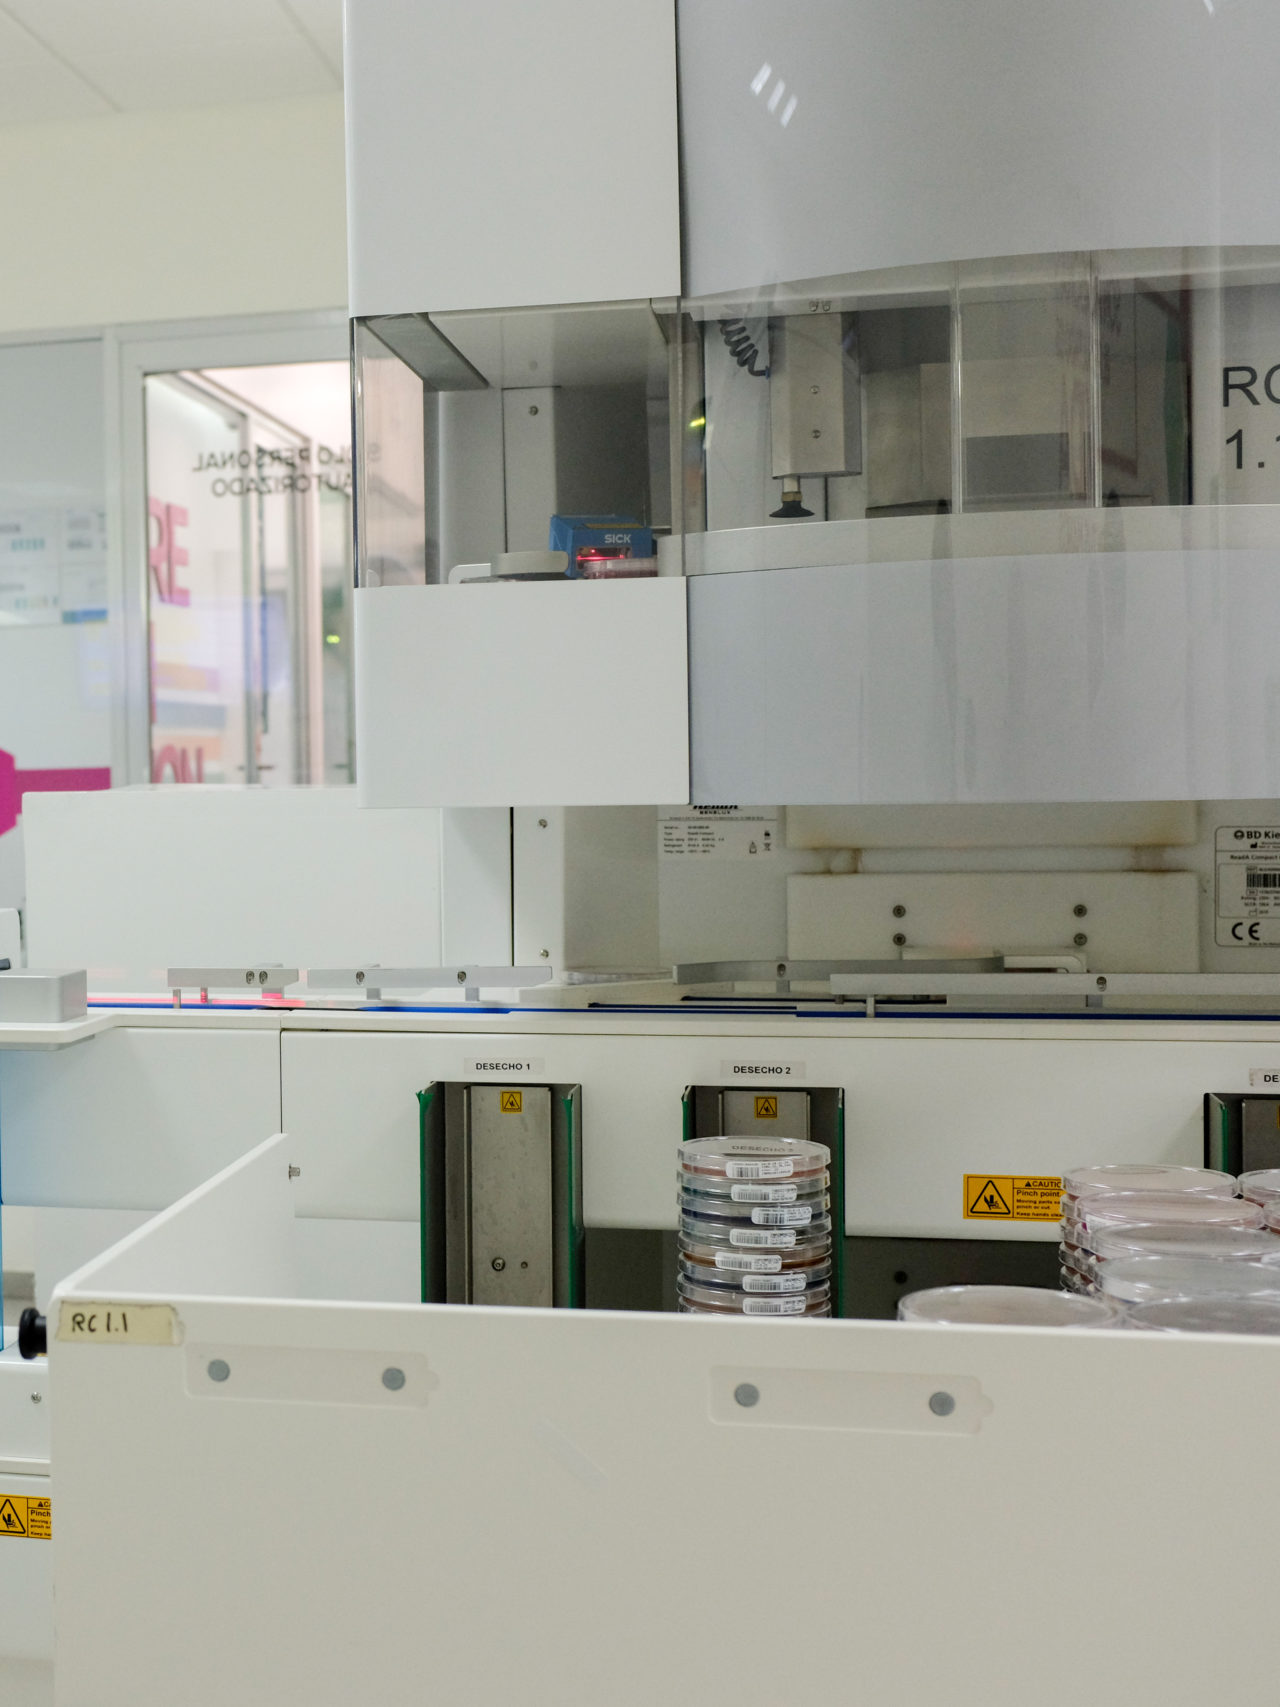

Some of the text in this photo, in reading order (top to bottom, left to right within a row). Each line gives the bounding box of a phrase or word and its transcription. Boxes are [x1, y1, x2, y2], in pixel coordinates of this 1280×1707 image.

[604, 534, 632, 544] SICK
[1246, 830, 1261, 840] BD
[475, 1062, 531, 1071] DESECHO 1
[733, 1065, 791, 1075] DESECHO 2
[1263, 1074, 1280, 1083] DE
[1016, 1189, 1038, 1197] Pinch
[72, 1312, 128, 1333] RC 1.1
